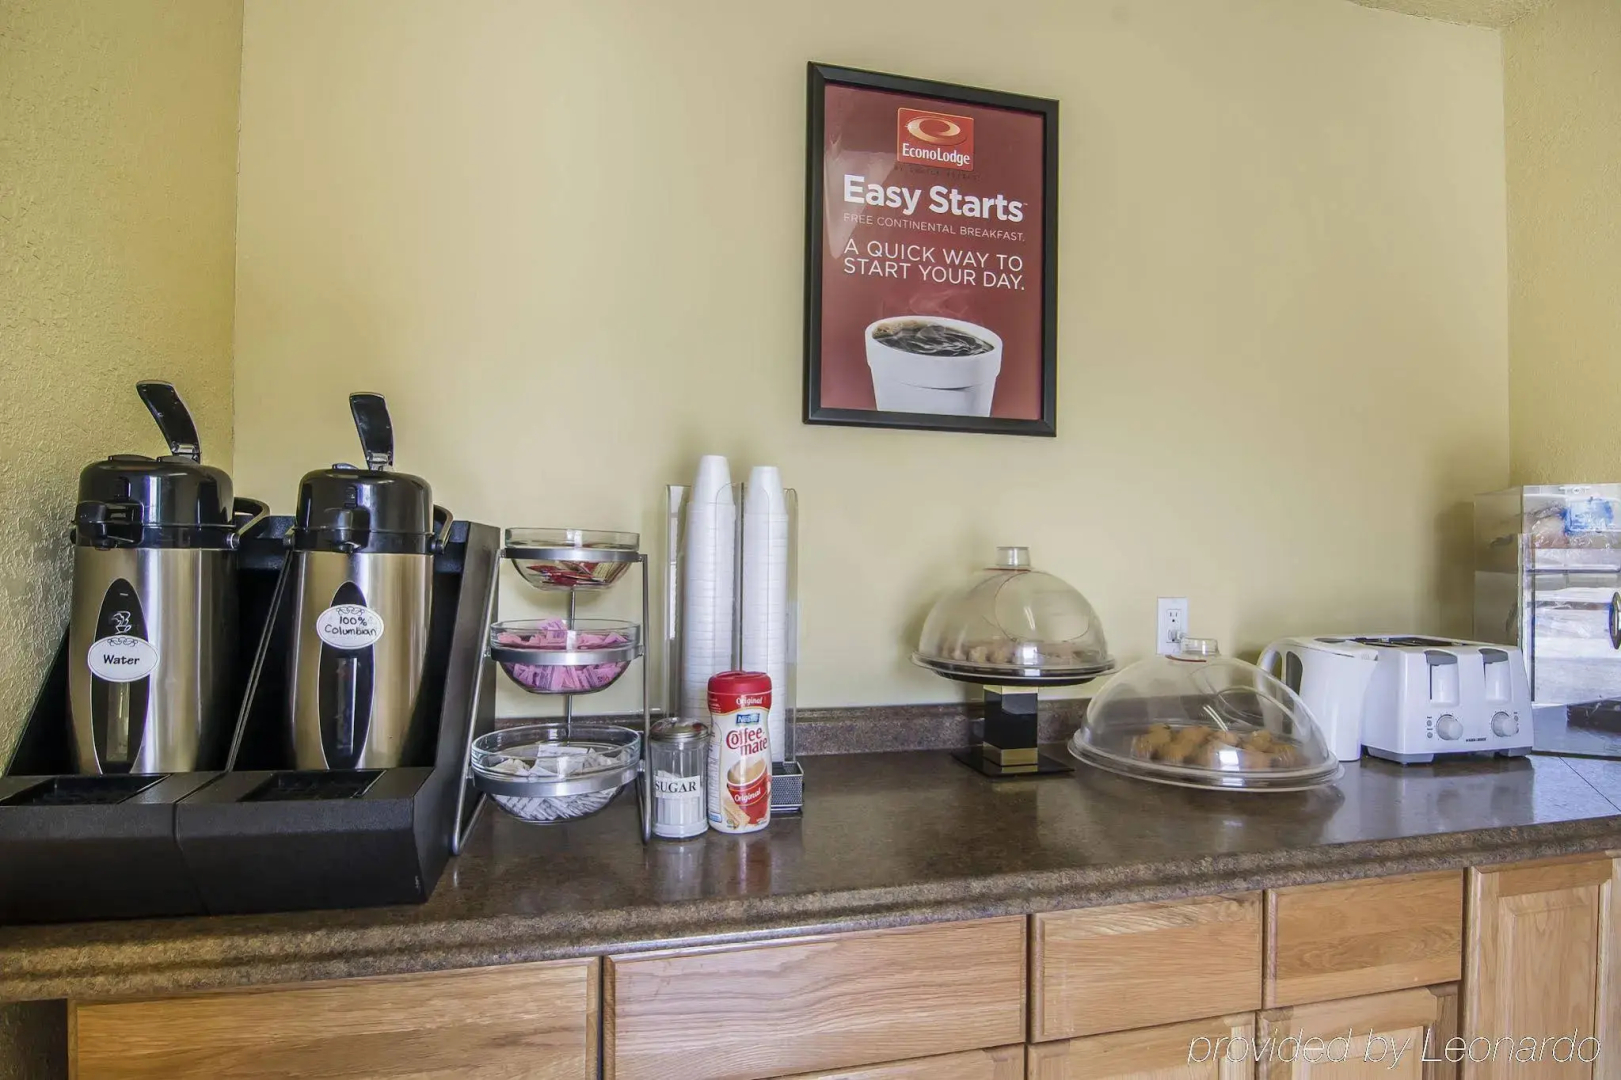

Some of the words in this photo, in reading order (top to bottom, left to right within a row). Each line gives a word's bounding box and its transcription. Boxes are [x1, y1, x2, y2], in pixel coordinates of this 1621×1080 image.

[902, 143, 970, 166] EconoLodge
[844, 174, 922, 215] Easy
[843, 213, 873, 225] FREE
[877, 217, 956, 234] CONTINENTAL
[960, 226, 1025, 242] BREAKFAST.
[844, 239, 859, 254] A
[867, 241, 935, 263] QUICK
[942, 249, 989, 268] WAY
[997, 254, 1023, 272] TO
[844, 258, 911, 279] START
[919, 265, 976, 286] YOUR
[983, 273, 1025, 291] DAY.
[339, 616, 368, 627] 100%
[324, 624, 377, 637] Columbian
[103, 654, 140, 665] Water
[736, 696, 763, 706] Original
[740, 737, 768, 756] mate
[655, 780, 697, 793] SUGAR
[734, 787, 761, 803] Original
